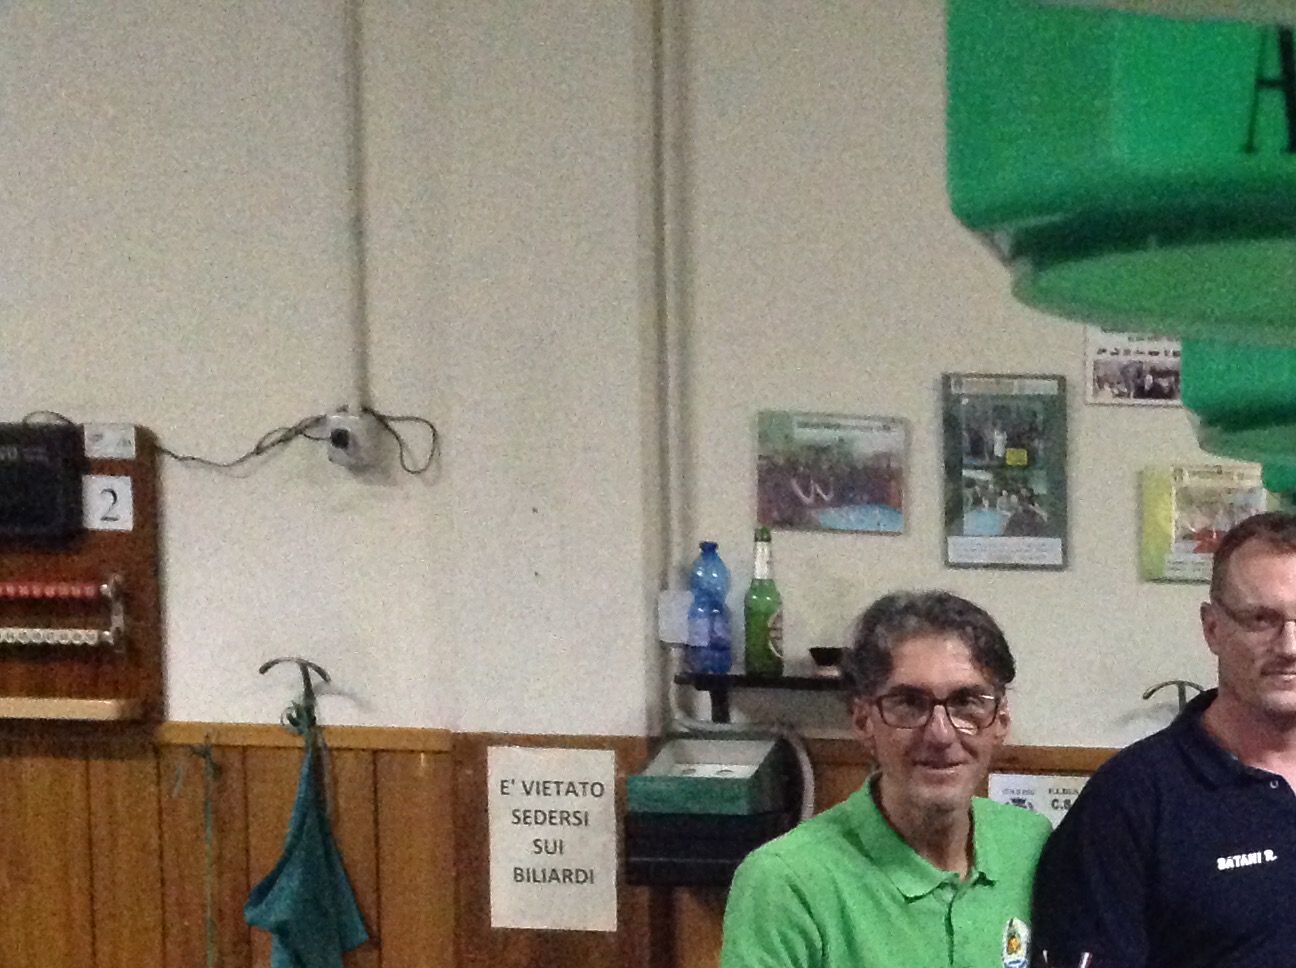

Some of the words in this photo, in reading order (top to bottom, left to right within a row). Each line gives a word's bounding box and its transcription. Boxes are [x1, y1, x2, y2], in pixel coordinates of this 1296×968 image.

[100, 488, 119, 522] 2
[500, 779, 516, 797] E'
[521, 780, 605, 798] VIETATO
[511, 809, 590, 828] SEDERSI
[532, 838, 564, 856] SUI
[513, 867, 595, 886] BILIARDI
